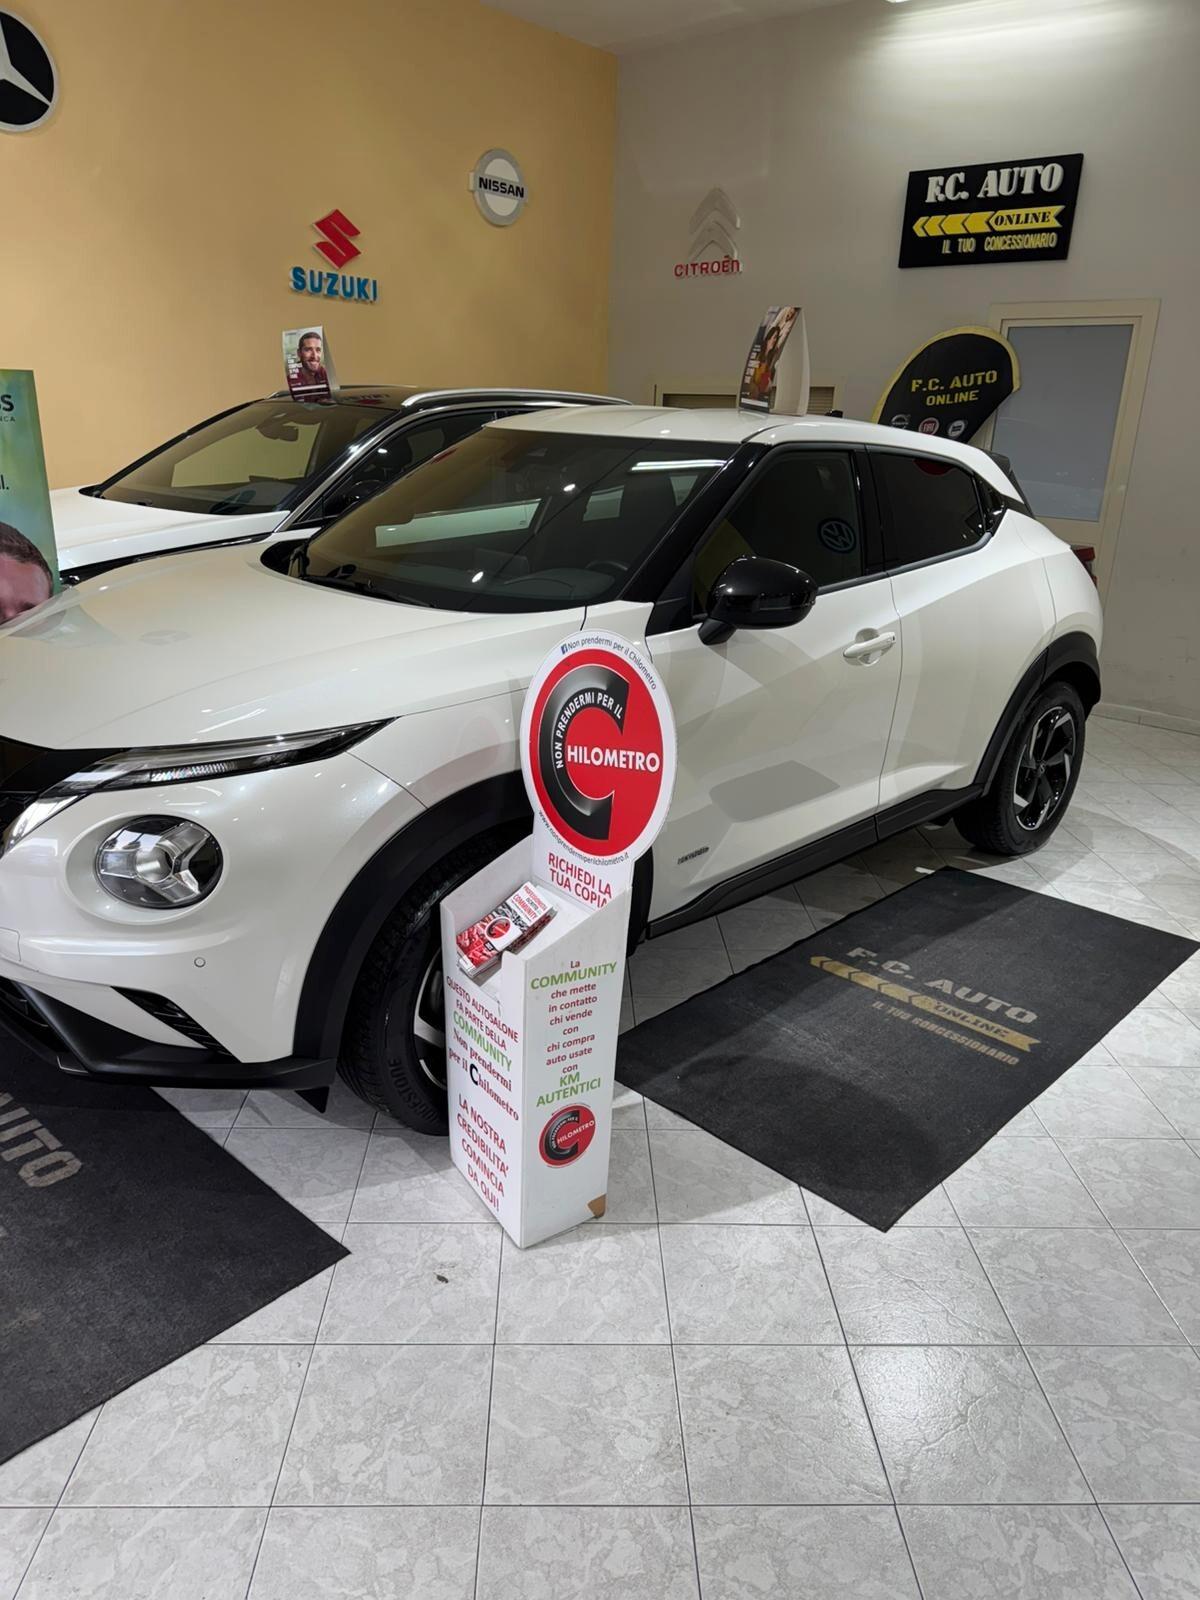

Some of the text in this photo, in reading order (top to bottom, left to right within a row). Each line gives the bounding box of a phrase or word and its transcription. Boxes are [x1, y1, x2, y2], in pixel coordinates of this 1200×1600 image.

[479, 176, 525, 198] NISSAN
[925, 163, 1064, 203] F.C. AUTO
[995, 211, 1051, 227] ONLINE
[942, 232, 1058, 254] IL TUO CONCESSIONARIO
[290, 266, 377, 301] SUZUKI
[911, 370, 998, 393] F.C. AUTO
[0, 394, 14, 412] S
[926, 390, 979, 406] ONLINE
[567, 642, 580, 650] Non
[581, 636, 612, 646] prendermi
[613, 642, 624, 653] per
[629, 651, 657, 690] Chilometro
[555, 692, 623, 769] NON PRENDERMI PER IL
[548, 852, 613, 899] RICHIEDI LA
[550, 868, 572, 892] TUA
[531, 962, 617, 990] COMMUNITY
[571, 960, 580, 969] La
[551, 983, 597, 999] che mette
[847, 947, 1037, 1024] F.C. AUTO
[446, 975, 519, 1043] QUESTO AUTOSALONE
[549, 996, 598, 1013] in contatto
[550, 1009, 593, 1026] chi vende
[933, 1001, 1010, 1038] ONLINE
[456, 999, 507, 1050] FA PARTE DELLA
[563, 1025, 579, 1035] con
[871, 1000, 1020, 1065] IL TUO CONCESSIONARIO
[453, 1011, 512, 1072] COMMUNITY
[546, 1046, 593, 1066] auto usate
[547, 1033, 595, 1053] chi compra
[453, 1028, 512, 1092] Non prendermi
[562, 1063, 578, 1074] con
[448, 1047, 519, 1121] per il Chilometro
[536, 1077, 601, 1107] AUTENTICI
[559, 1072, 580, 1088] KM
[459, 1093, 506, 1154] LA NOSTRA
[0, 1091, 83, 1188] UTO
[462, 1138, 504, 1197] COMINCIA
[468, 1163, 499, 1212] DA QUI!
